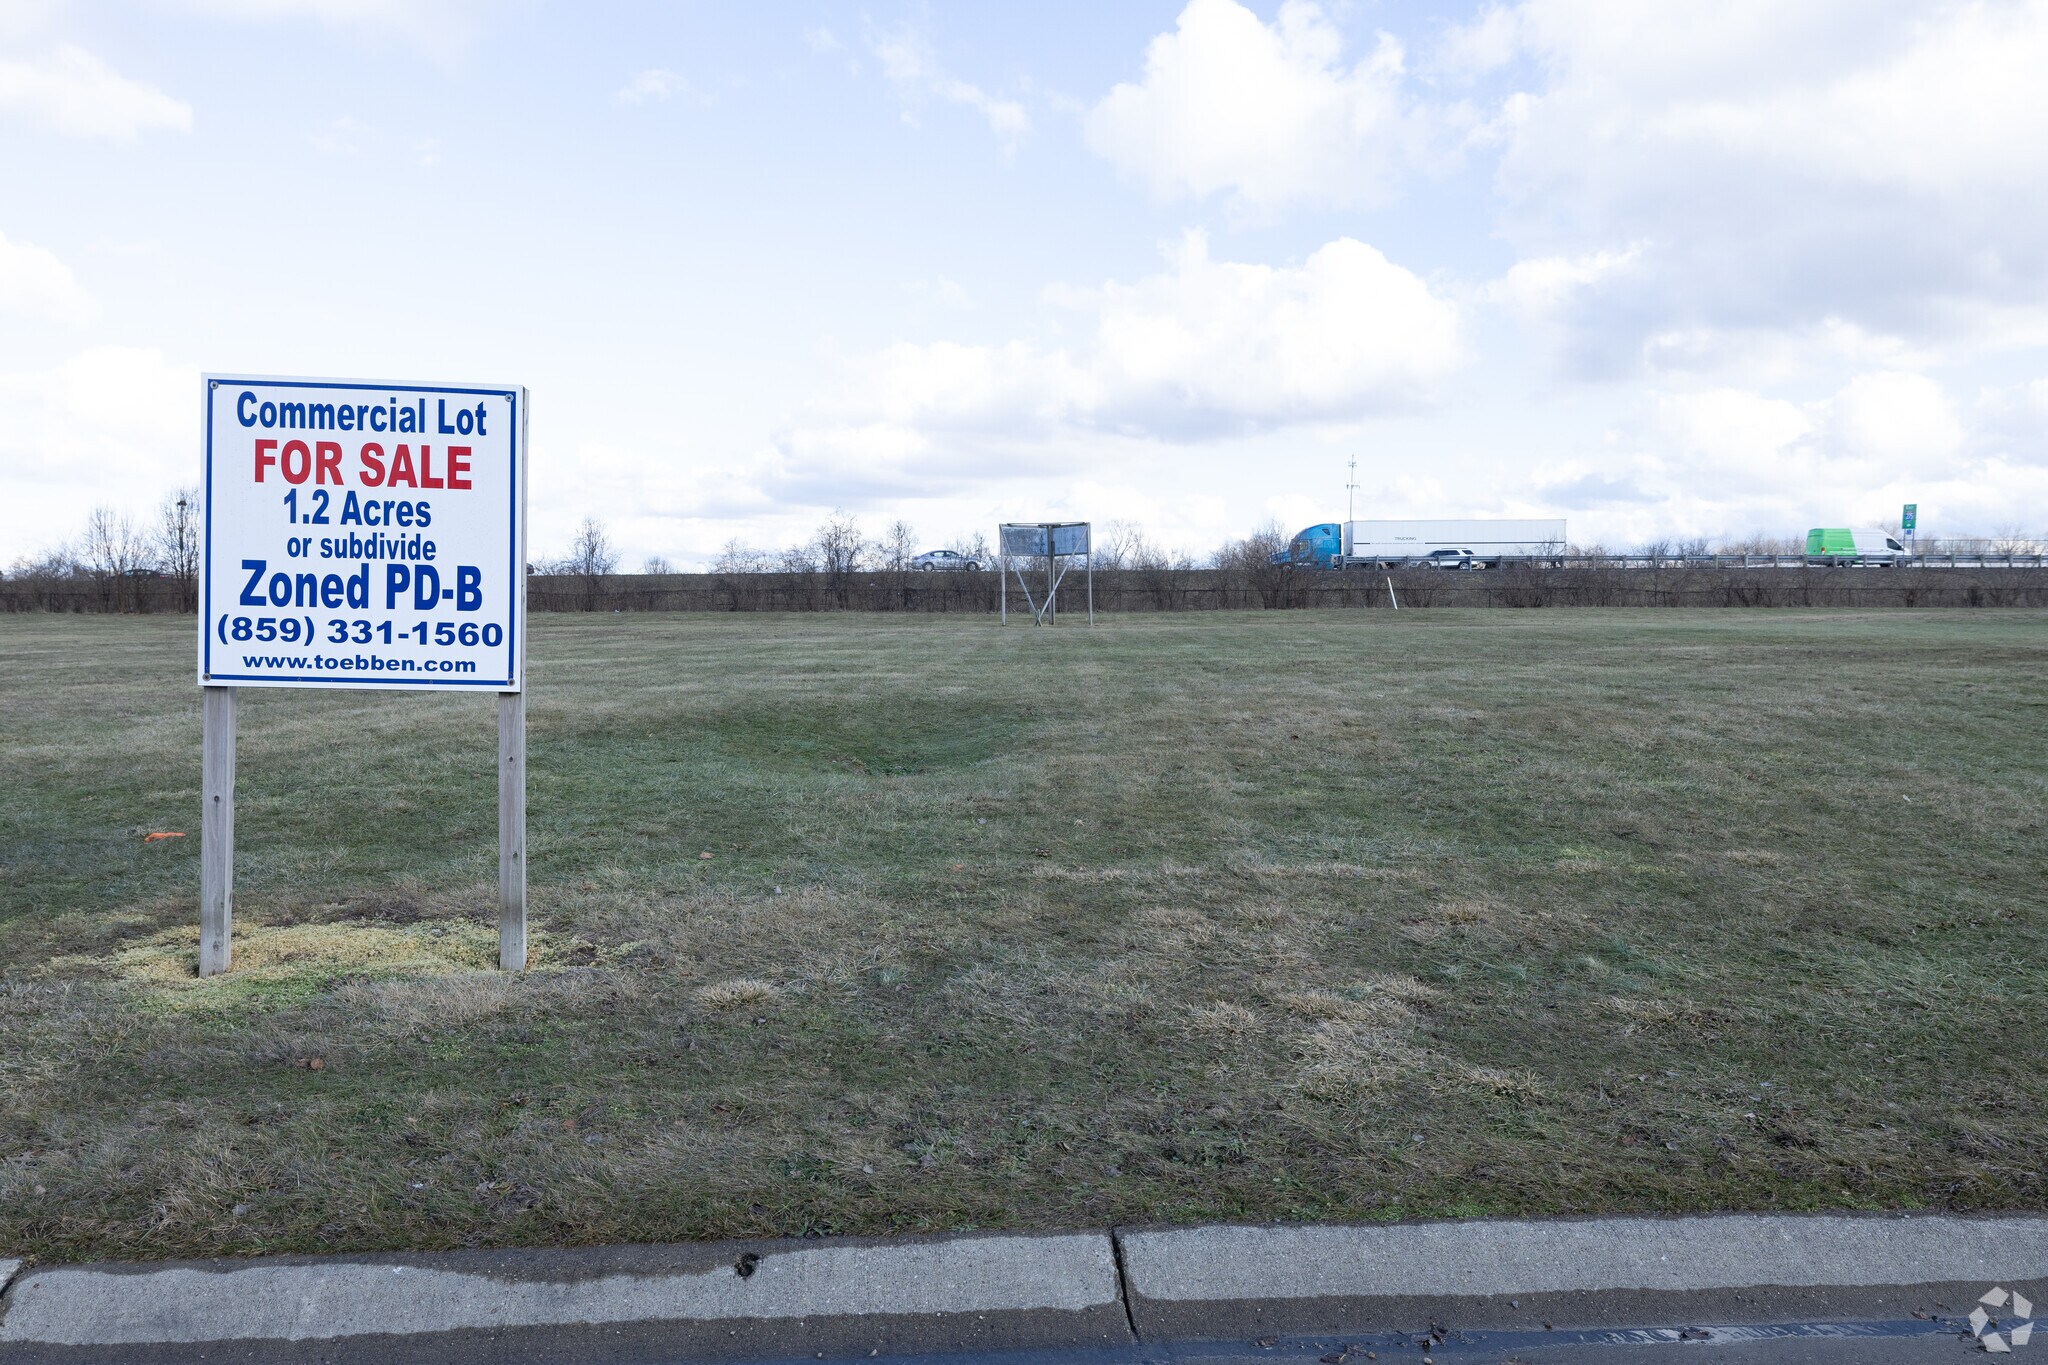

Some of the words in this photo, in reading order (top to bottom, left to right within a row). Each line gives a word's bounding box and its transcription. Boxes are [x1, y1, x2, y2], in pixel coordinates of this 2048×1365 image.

[237, 391, 426, 434] Commercial
[438, 398, 488, 436] Lot
[254, 439, 345, 486] FOR
[359, 443, 473, 490] SALE
[283, 488, 330, 525] 1.2
[340, 489, 432, 528] Acres
[286, 536, 313, 559] or
[320, 531, 437, 562] subdivide
[239, 558, 370, 610] Zoned
[385, 562, 484, 612] PD-B
[217, 613, 316, 647] (859)
[327, 618, 504, 648] 331-1560
[242, 654, 477, 673] www.toebben.com
